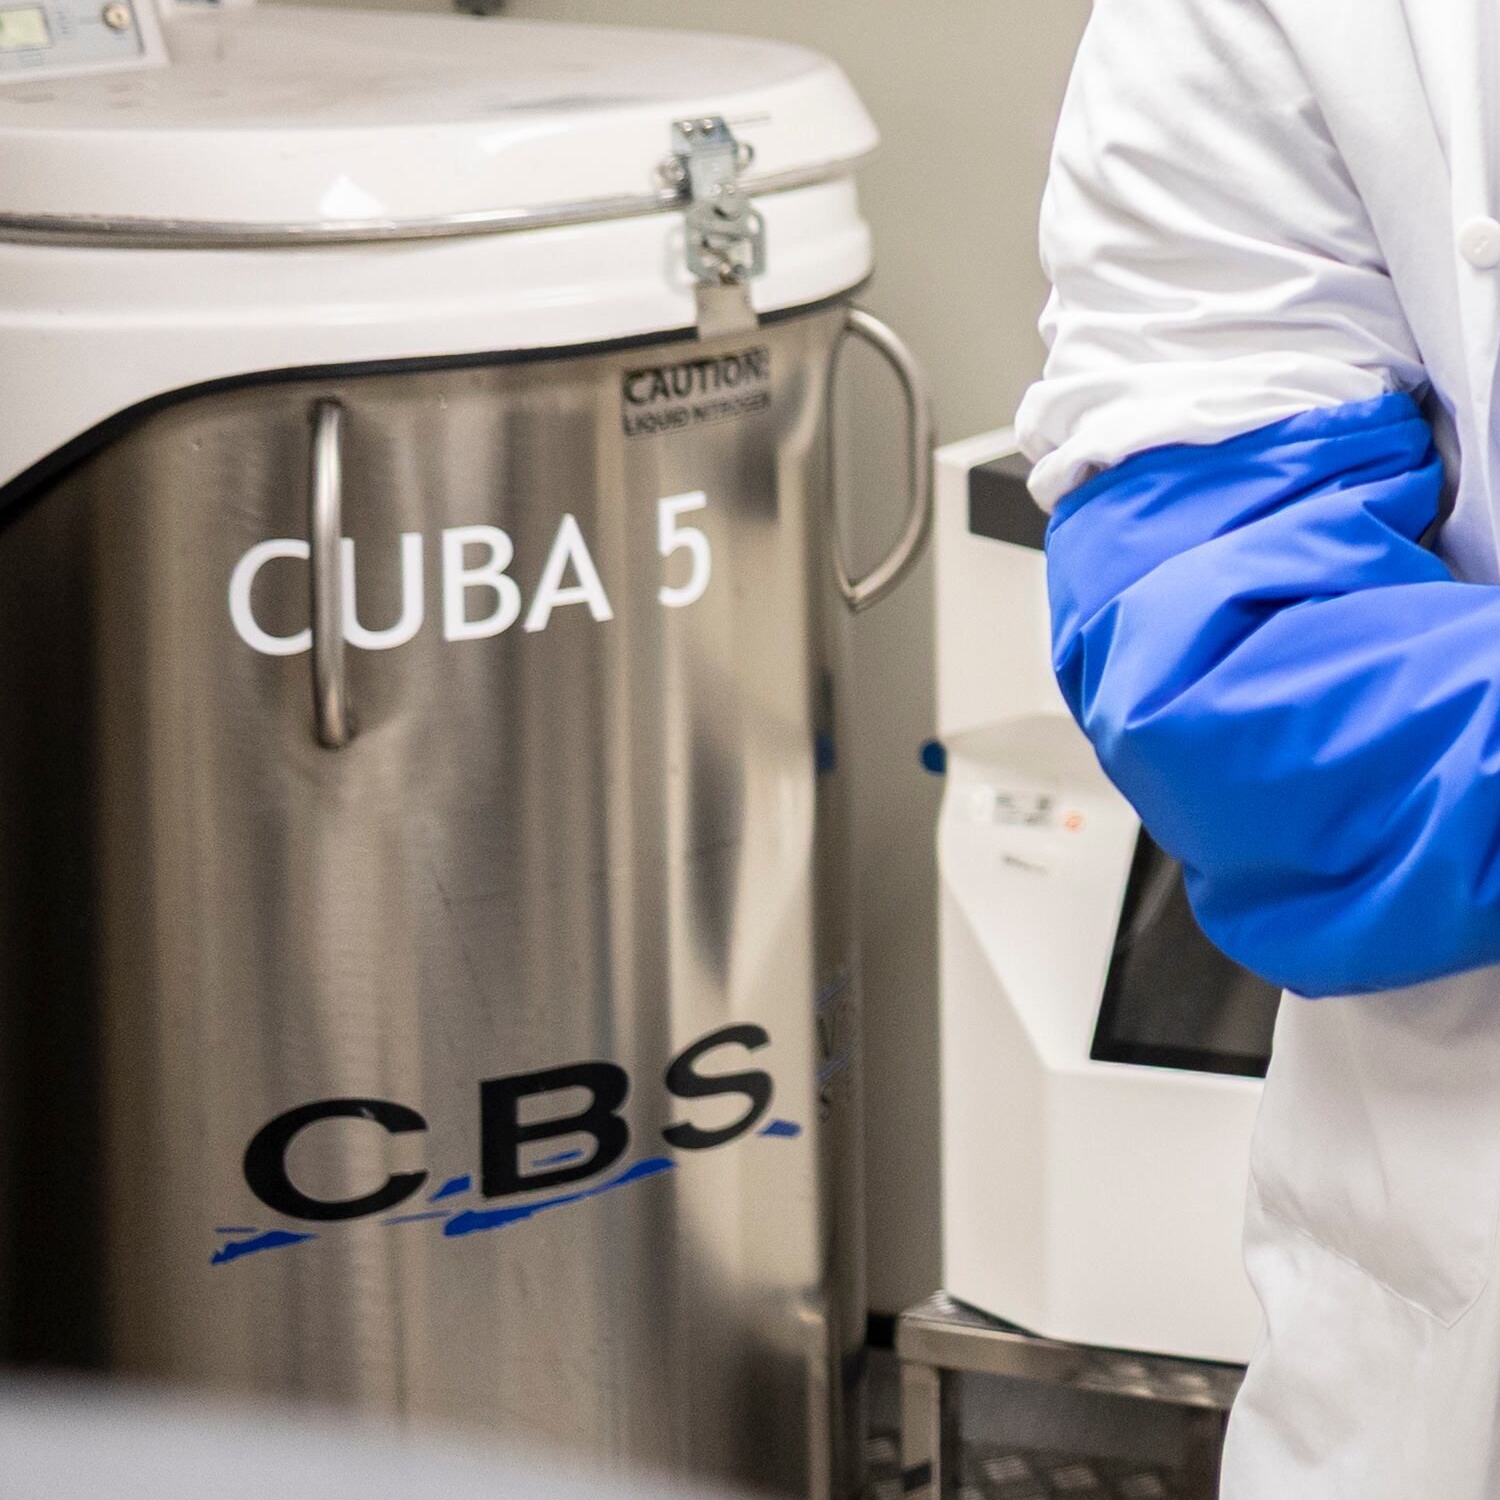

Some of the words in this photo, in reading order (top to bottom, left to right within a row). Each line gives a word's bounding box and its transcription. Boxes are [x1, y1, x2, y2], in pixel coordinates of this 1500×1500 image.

[227, 512, 614, 657] CUBA
[656, 489, 712, 607] 5
[242, 1023, 776, 1222] CBS
